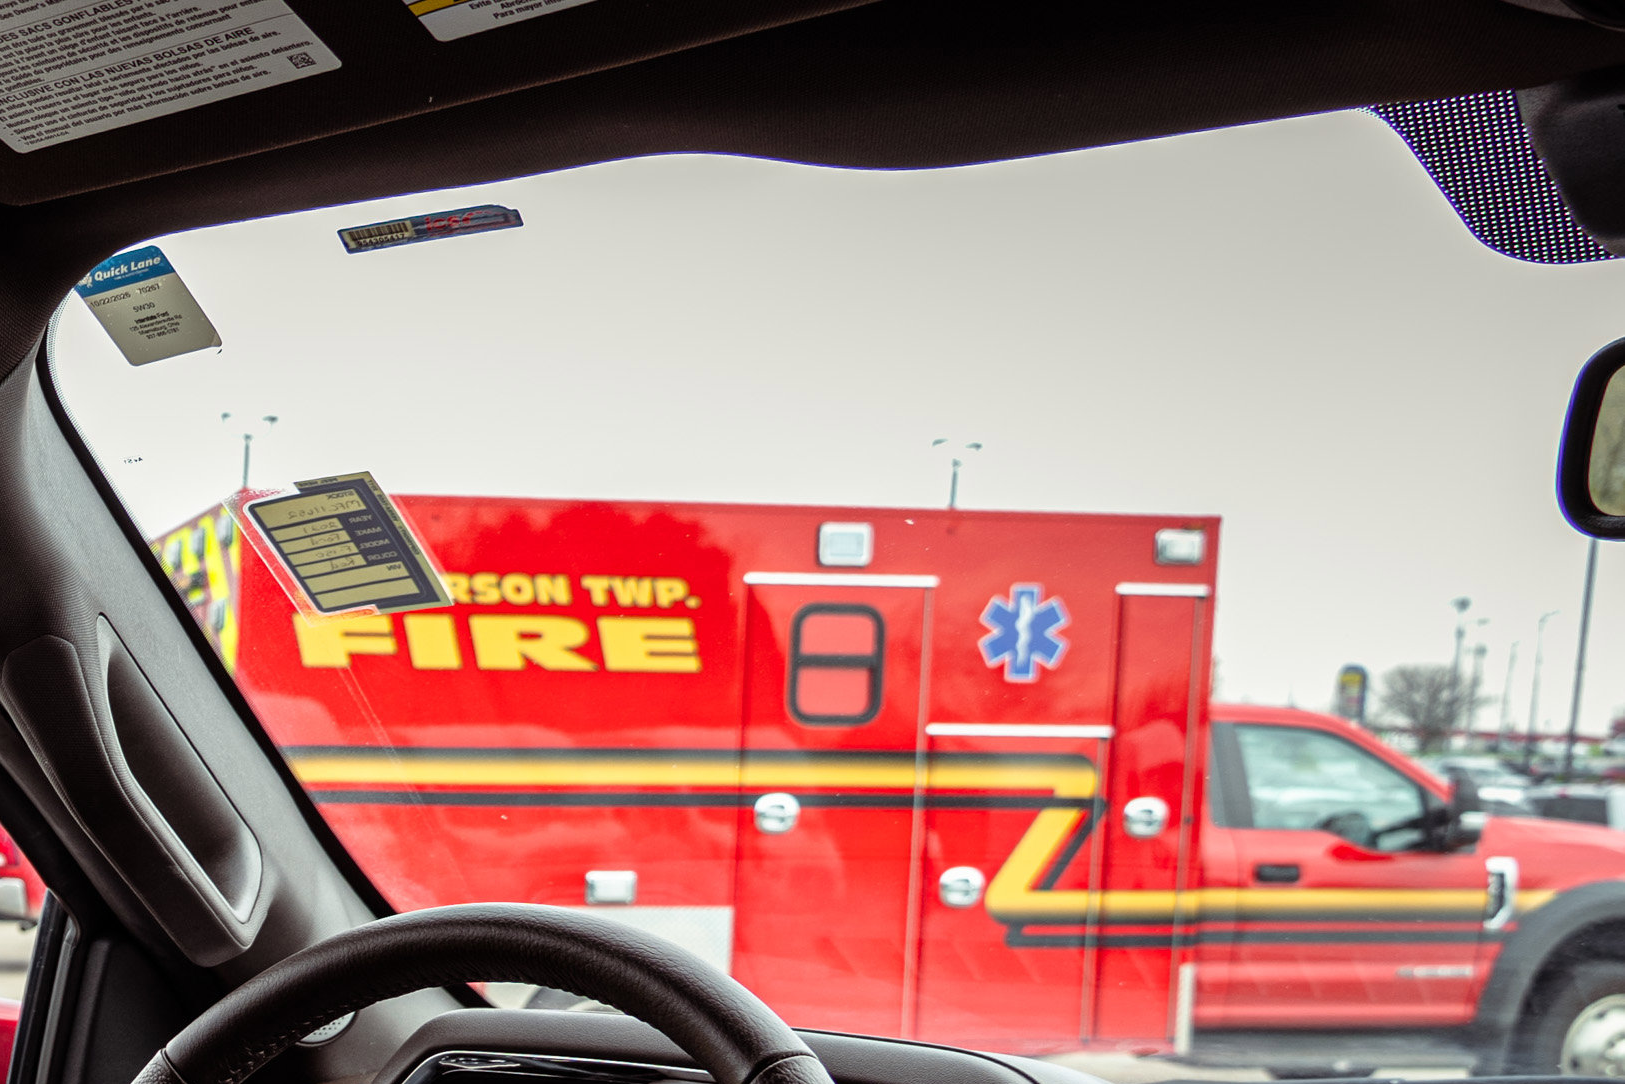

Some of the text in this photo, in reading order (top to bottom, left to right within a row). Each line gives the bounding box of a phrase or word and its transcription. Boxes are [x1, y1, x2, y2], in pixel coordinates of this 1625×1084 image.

[18, 22, 51, 36] SACS
[53, 0, 132, 25] GONFLABLES
[492, 8, 515, 19] Para
[515, 1, 543, 13] mayor
[54, 77, 80, 88] CON
[80, 70, 104, 81] LAS
[105, 57, 152, 74] NUEVAS
[153, 42, 203, 60] BOLSAS
[204, 36, 223, 46] DE
[225, 27, 254, 40] AIRE
[95, 256, 161, 281] Quick Lane
[133, 302, 155, 313] 5W30
[581, 575, 702, 609] TWP.
[293, 613, 702, 673] FIRE
